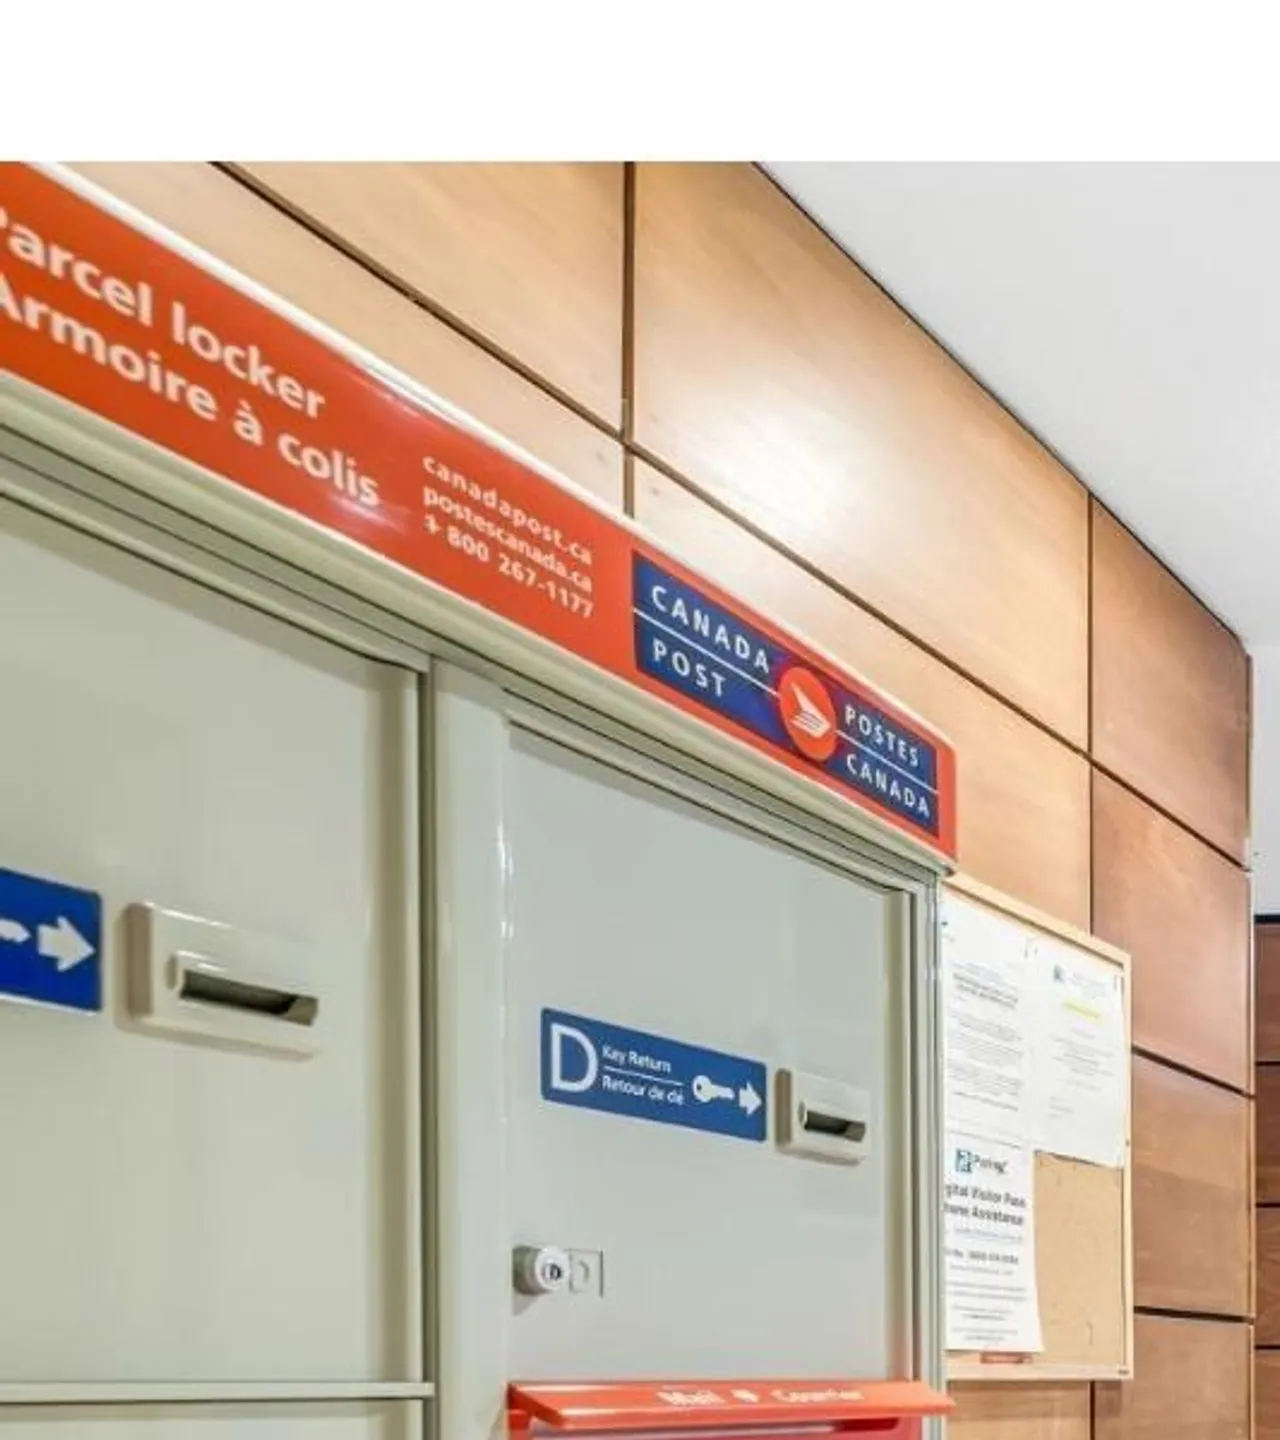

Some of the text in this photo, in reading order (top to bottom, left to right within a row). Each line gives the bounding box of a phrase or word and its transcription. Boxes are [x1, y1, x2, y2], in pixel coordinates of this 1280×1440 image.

[0, 206, 325, 420] arcel locker
[233, 400, 263, 446] à
[278, 433, 381, 507] colis
[422, 456, 592, 566] canadapost.ca
[423, 486, 592, 592] postescanada.ca
[447, 525, 490, 563] 800
[499, 552, 594, 619] 267-1177
[651, 584, 770, 674] CANADA
[652, 639, 727, 698] POST
[844, 703, 920, 768] POSTES
[846, 754, 931, 819] CANADA
[551, 1022, 599, 1093] D
[602, 1044, 672, 1073] Key Return
[602, 1075, 645, 1097] Retour
